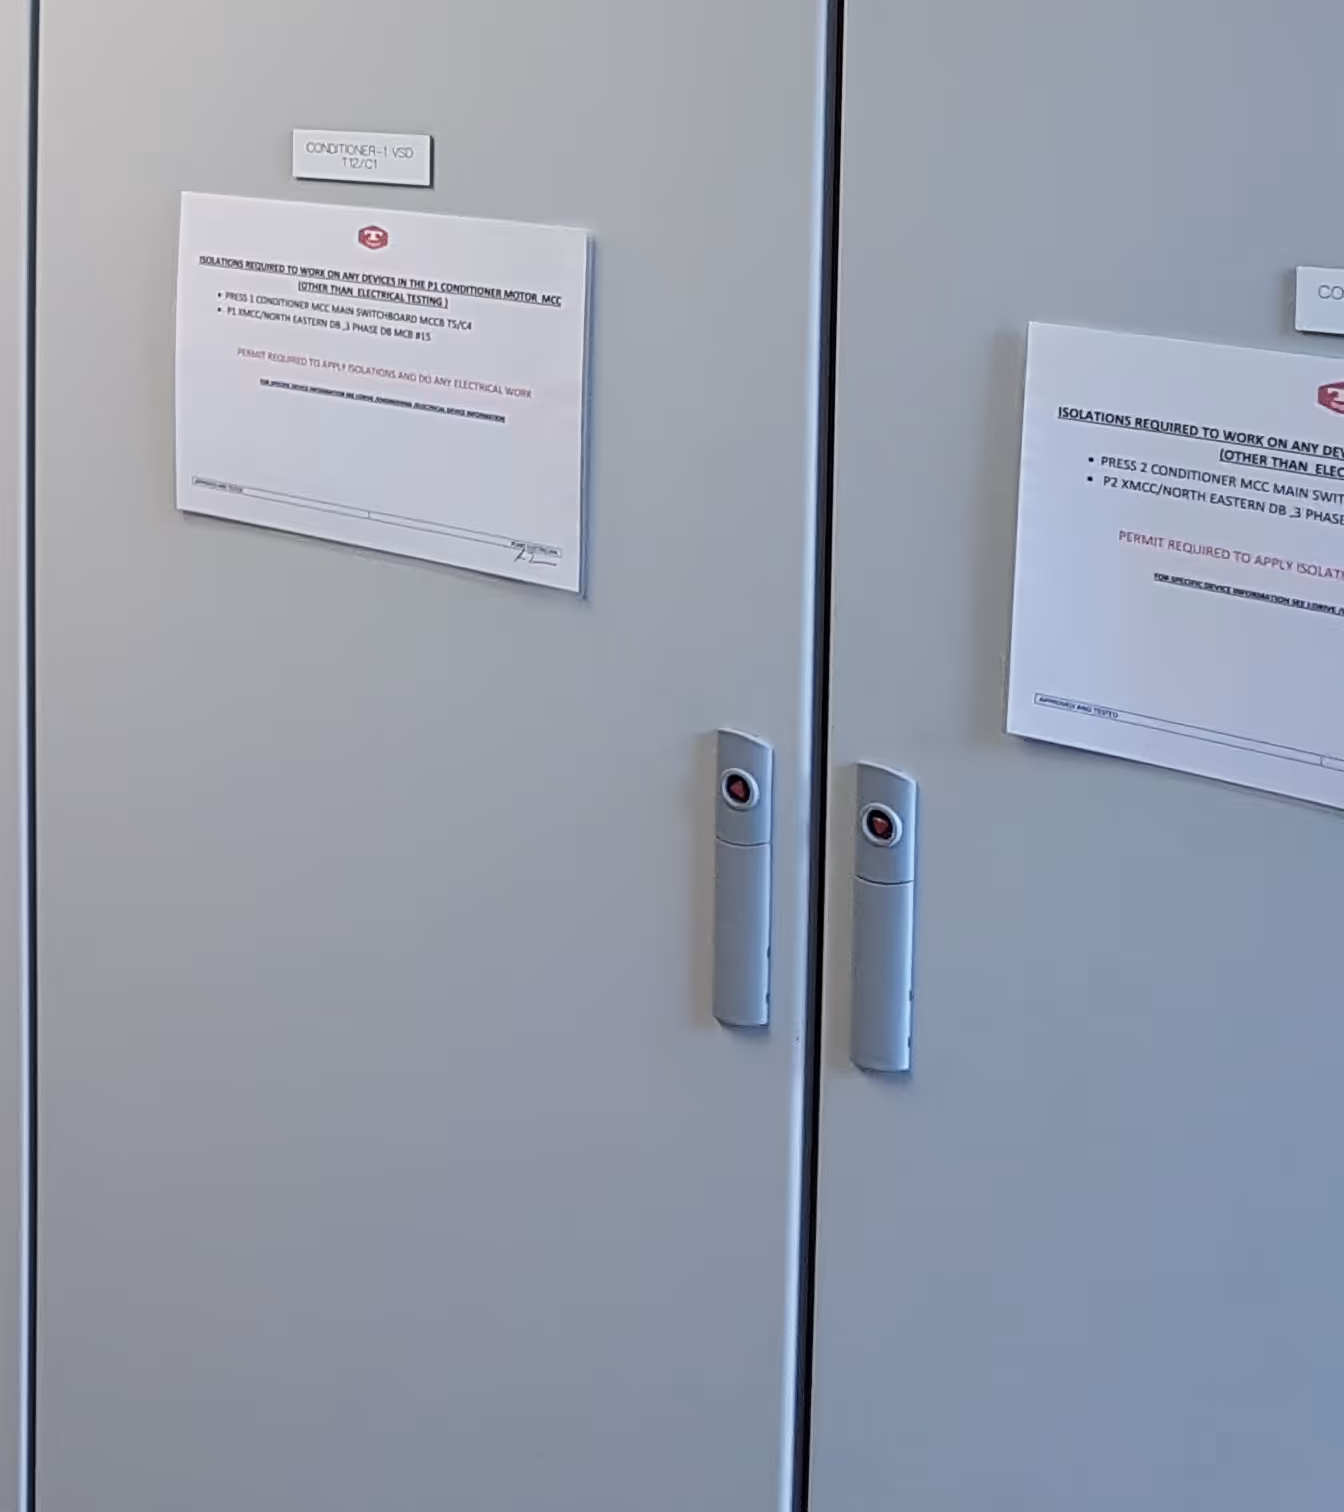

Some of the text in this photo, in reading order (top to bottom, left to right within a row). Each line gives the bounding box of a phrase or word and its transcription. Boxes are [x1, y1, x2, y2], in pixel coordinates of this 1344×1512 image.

[392, 146, 414, 159] VSD
[199, 256, 562, 306] ISOLATIONS REQUIRED TO WORK ON ANY DEVICES IN THE P1 CONDITIONER MOTOR MCC
[330, 284, 353, 295] THAN
[357, 288, 404, 302] ELECTRICAL
[407, 293, 442, 305] TESTING
[225, 292, 247, 302] PRESS
[256, 296, 308, 309] CONDITIONER
[312, 302, 330, 313] MCC
[332, 305, 354, 315] MAIN
[356, 308, 417, 323] SWITCHBOARD
[293, 315, 327, 327] EASTERN
[330, 320, 341, 329] DB
[352, 323, 378, 335] PHASE
[394, 328, 413, 339] MCB
[237, 347, 532, 398] PERMIT REQUIRED TO APPLY ISOLATIONS AND DO ANY ELECTRICAL WORK
[1058, 406, 1131, 426] ISOLATIONS
[1135, 417, 1199, 436] REQUIRED
[1202, 426, 1219, 439] TO
[1223, 430, 1264, 446] WORK
[1267, 437, 1288, 449] ON
[1292, 440, 1319, 454] ANY
[1101, 456, 1344, 505] PRESS 2 CONDITIONER MCC MAIN SWIT
[1220, 448, 1344, 478] (OTHER THAN ELEC
[1104, 476, 1118, 488] P2
[1121, 479, 1206, 502] XMCC/NORTH
[1210, 493, 1265, 512] EASTERN
[1269, 503, 1286, 515] DB
[1305, 508, 1344, 525] PHASE
[1119, 530, 1163, 548] PERMIT
[1168, 539, 1230, 560] REQUIRED
[1233, 550, 1251, 564] TO
[1254, 555, 1293, 571] APPLY
